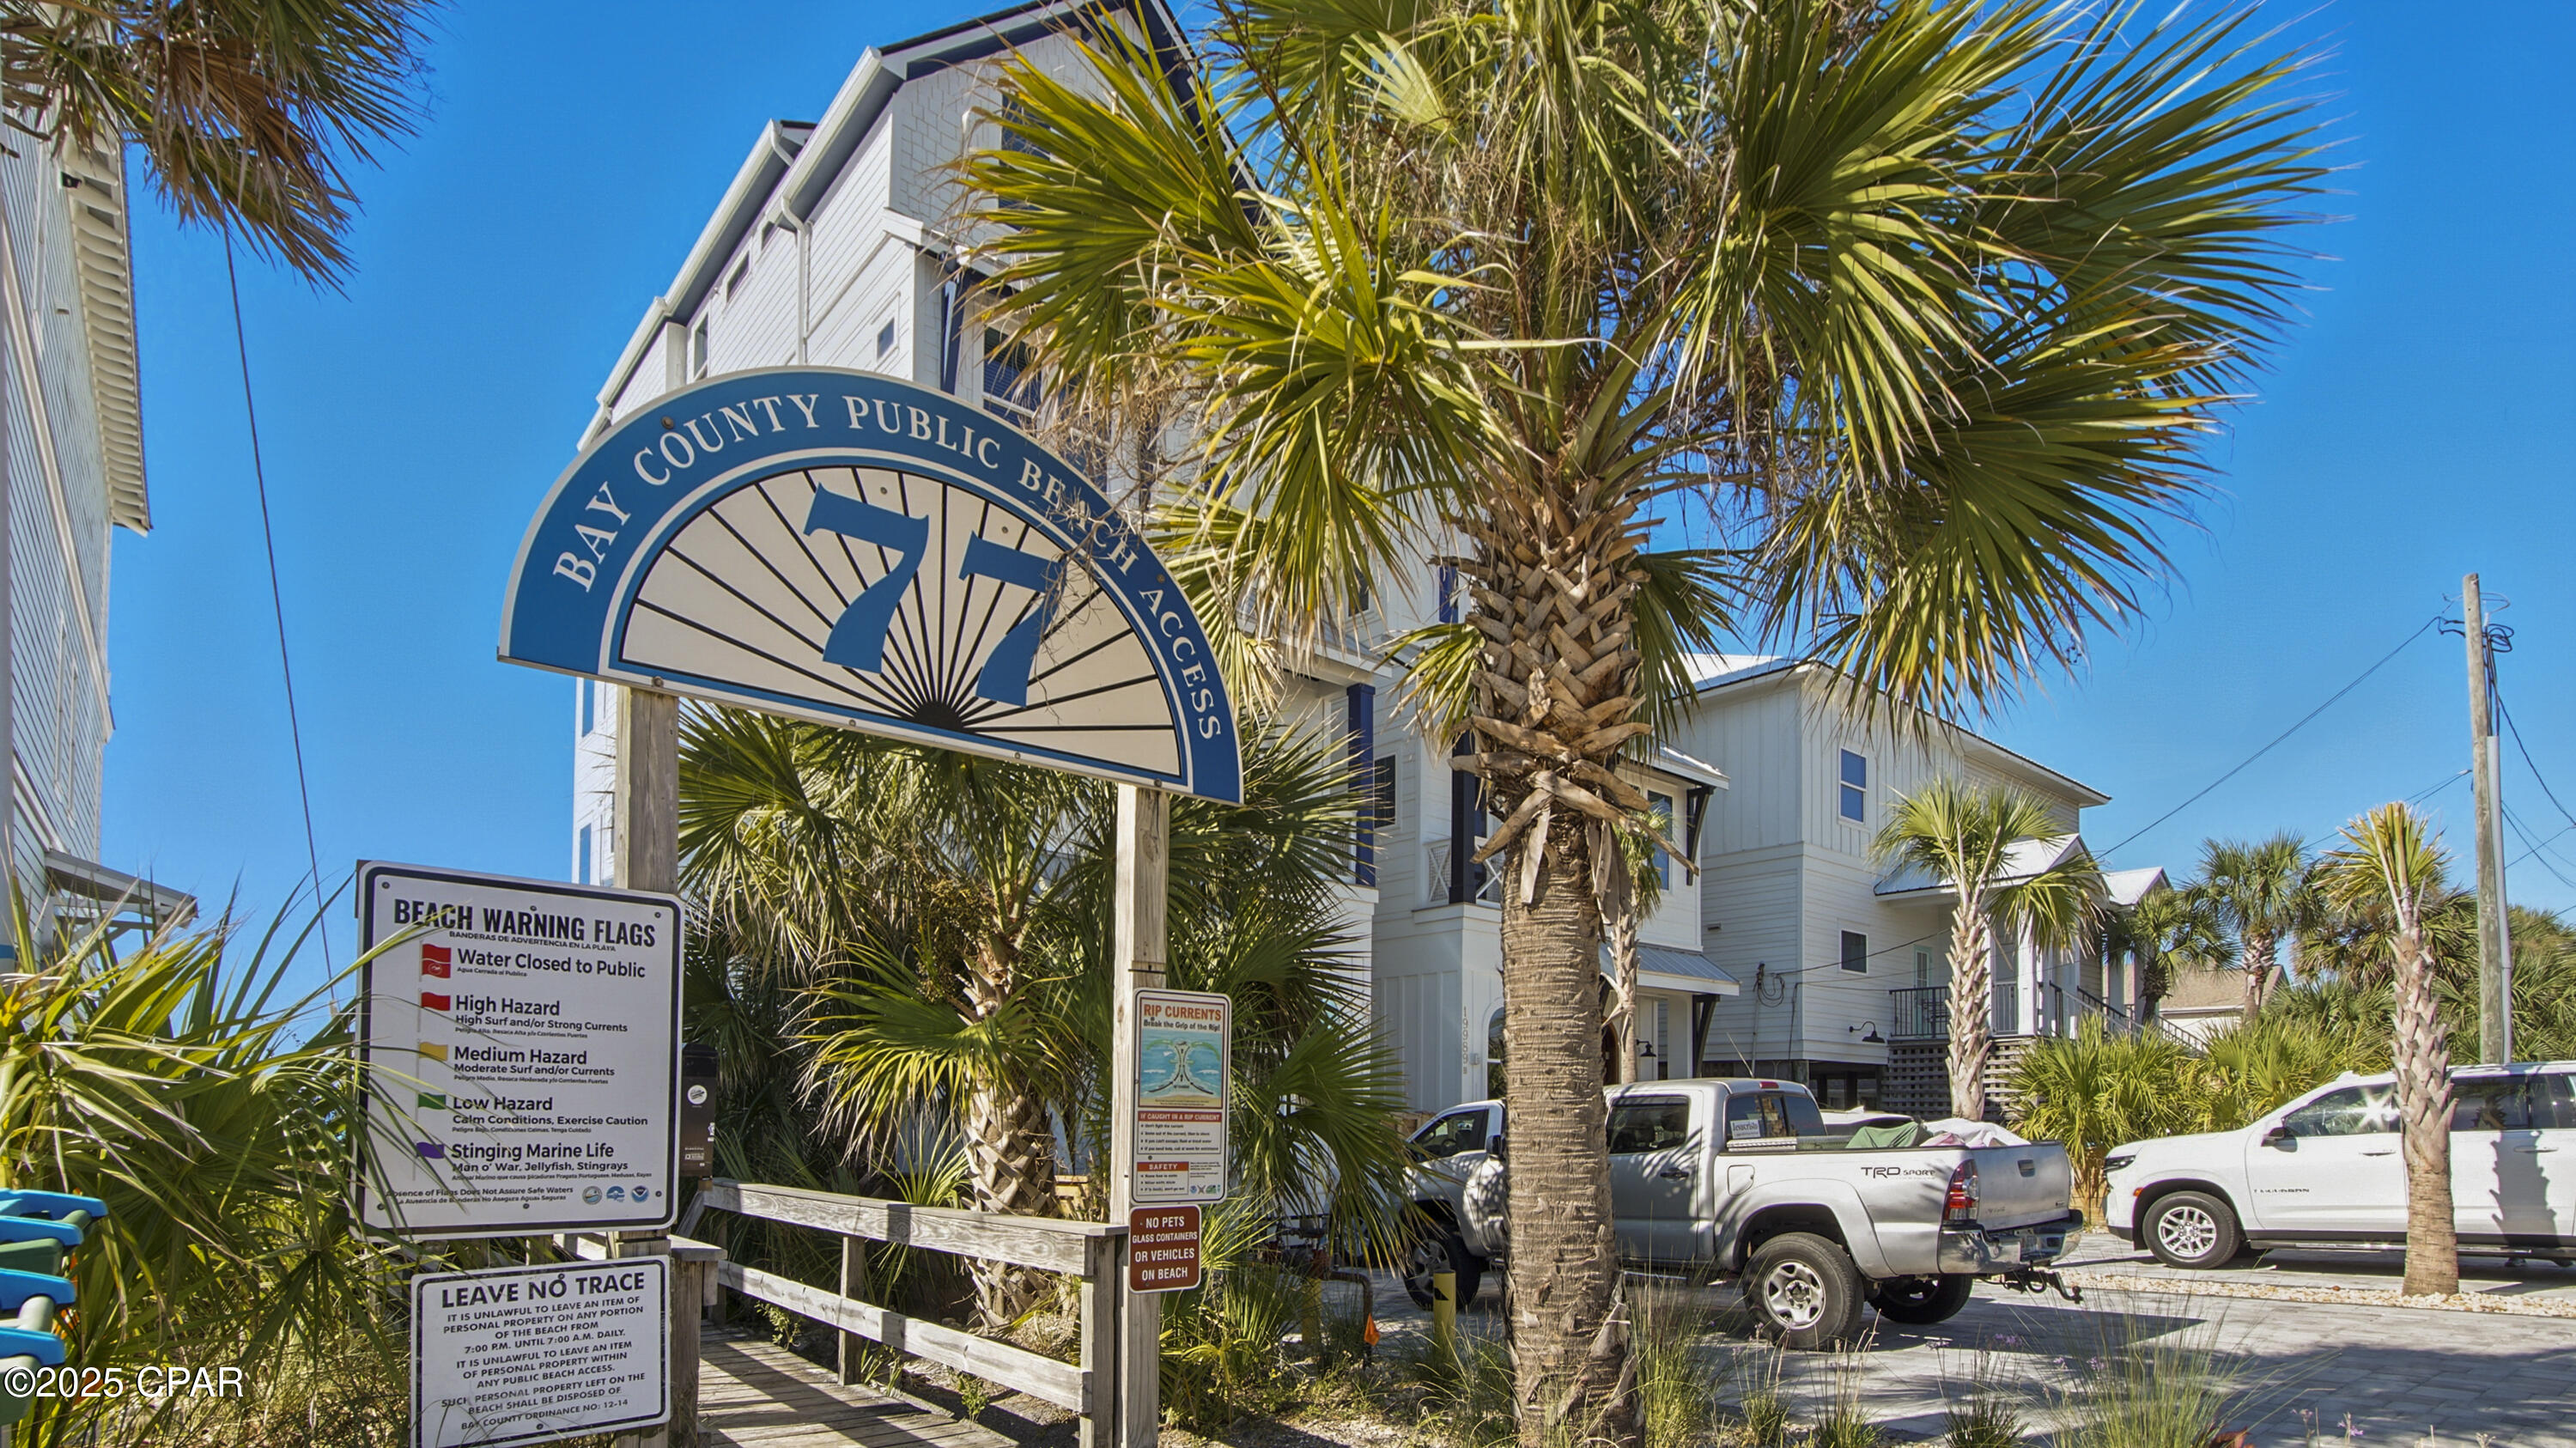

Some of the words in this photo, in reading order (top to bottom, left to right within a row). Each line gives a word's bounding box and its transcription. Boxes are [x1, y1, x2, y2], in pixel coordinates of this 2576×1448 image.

[552, 482, 631, 593] BAY
[634, 393, 821, 485] COUNTY
[841, 395, 1002, 469] PUBLIC
[1139, 587, 1222, 740] ACCESS
[394, 898, 472, 930] BEACH
[483, 908, 585, 940] WARNING
[594, 920, 655, 947] FLAGS
[449, 931, 495, 941] BANDERAS
[511, 936, 568, 947] ADVERTENCIA
[458, 948, 511, 967] Water
[515, 953, 571, 971] Closed
[575, 959, 592, 974] to
[597, 960, 646, 977] Public
[456, 995, 496, 1015] High
[501, 998, 560, 1016] Hazard
[1144, 1004, 1162, 1017] RIP
[1165, 1005, 1221, 1021] CURRENTS
[456, 1015, 482, 1026] High
[485, 1016, 508, 1025] Surf
[510, 1018, 544, 1029] and/or
[547, 1020, 582, 1031] Strong
[585, 1021, 628, 1031] Currents
[1144, 1019, 1162, 1028] Break
[1175, 1021, 1188, 1031] Grip
[1208, 1024, 1221, 1032] Rip!
[454, 1046, 525, 1062] Medium
[530, 1049, 587, 1064] Hazard
[454, 1063, 507, 1074] Moderate
[510, 1065, 533, 1074] Surf
[535, 1065, 568, 1076] and/or
[571, 1067, 615, 1076] Currents
[453, 1097, 489, 1110] Low
[494, 1097, 553, 1110] Hazard
[453, 1115, 484, 1124] Calm
[488, 1115, 554, 1125] Conditions,
[557, 1116, 603, 1125] Exercise
[606, 1116, 647, 1125] Caution
[452, 1143, 522, 1161] Stinging
[526, 1142, 582, 1158] Marine
[586, 1142, 614, 1158] Life
[453, 1163, 479, 1171] Man
[495, 1163, 522, 1172] War,
[525, 1162, 574, 1172] Jellyfish,
[577, 1161, 628, 1171] Stingrays
[1861, 1167, 1900, 1178] TRD
[1145, 1217, 1159, 1228] NO
[1162, 1216, 1185, 1228] PETS
[1132, 1233, 1155, 1244] GLASS
[1156, 1232, 1198, 1243] CONTAINERS
[1134, 1250, 1148, 1262] OR
[1151, 1247, 1194, 1262] VEHICLES
[1141, 1269, 1155, 1281] ON
[1157, 1267, 1188, 1280] BEACH
[442, 1283, 519, 1308] LEAVE
[528, 1279, 567, 1300] NO
[575, 1272, 645, 1295] TRACE
[447, 1314, 457, 1323] IT
[474, 1308, 532, 1320] UNLAWFUL
[535, 1305, 549, 1314] TO
[552, 1302, 581, 1312] LEAVE
[584, 1300, 598, 1309] AN
[602, 1297, 624, 1306] ITEM
[444, 1322, 500, 1334] PERSONAL
[504, 1316, 554, 1327] PROPERTY
[557, 1313, 574, 1322] ON
[577, 1311, 597, 1320] ANY
[600, 1306, 643, 1317] PORTION
[495, 1331, 508, 1340] OF
[512, 1329, 532, 1337] THE
[535, 1324, 568, 1335] BEACH
[571, 1322, 598, 1330] FROM
[465, 1344, 488, 1354] 7:00
[491, 1342, 511, 1351] P.M.
[515, 1337, 545, 1348] UNTIL
[548, 1335, 569, 1345] 7:00
[597, 1329, 625, 1339] DAILY.
[457, 1360, 466, 1369] IT
[470, 1359, 479, 1367] IS
[483, 1353, 540, 1366] UNLAWFUL
[544, 1350, 556, 1359] TO
[560, 1346, 589, 1356] LEAVE
[592, 1344, 607, 1353] AN
[610, 1341, 632, 1350] ITEM
[463, 1371, 477, 1379] OF
[481, 1365, 536, 1377] PERSONAL
[539, 1357, 588, 1370] PROPERTY
[591, 1352, 627, 1362] WITHIN
[477, 1378, 501, 1389] ANY
[503, 1373, 539, 1385] PUBLIC
[543, 1369, 574, 1380] BEACH
[578, 1364, 616, 1375] ACCESS.
[475, 1390, 530, 1402] PERSONAL
[532, 1382, 582, 1394] PROPERTY
[586, 1378, 605, 1388] LEFT
[609, 1376, 624, 1384] ON
[628, 1372, 646, 1382] THE
[469, 1403, 503, 1415] BEACH
[507, 1399, 538, 1409] SHALL
[542, 1395, 553, 1404] BE
[557, 1389, 605, 1402] DISPOSED
[461, 1421, 480, 1430] BAY
[483, 1415, 523, 1427] COUNTY
[525, 1406, 580, 1420] ORDINANCE
[604, 1399, 628, 1408] 12-14
